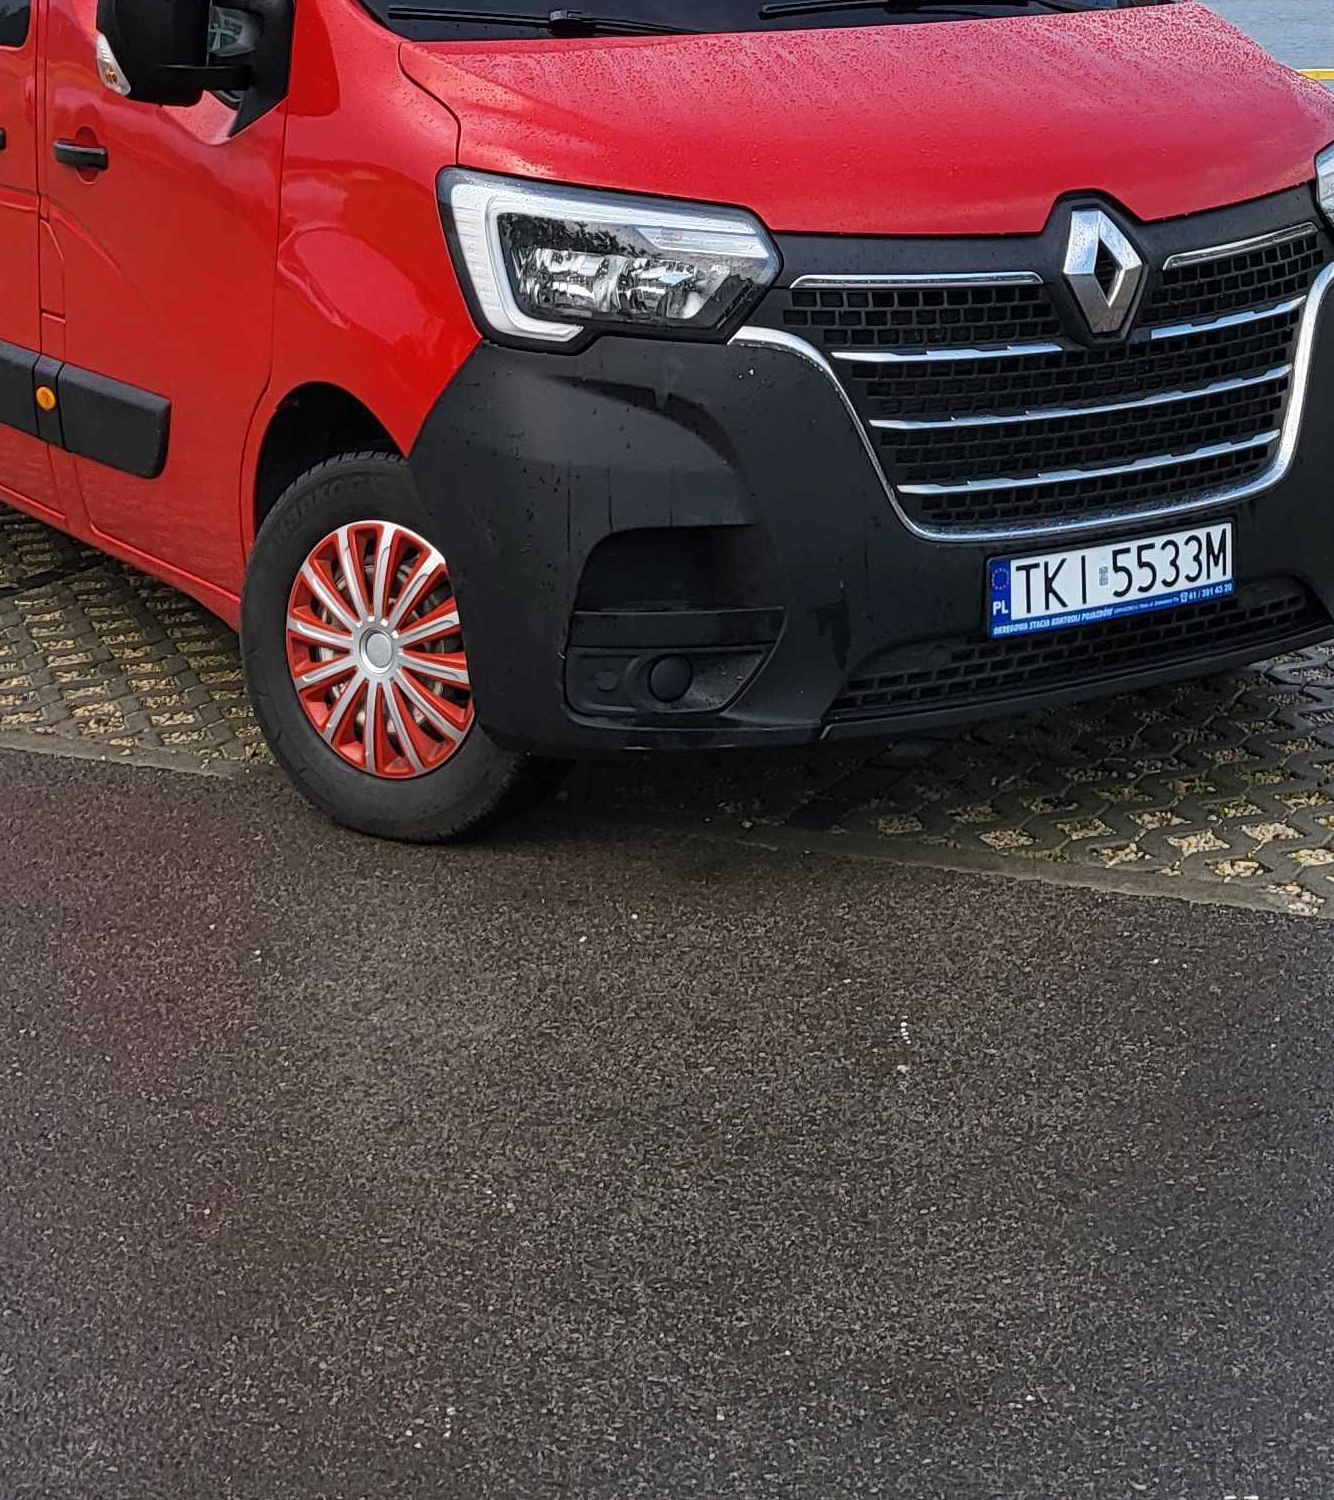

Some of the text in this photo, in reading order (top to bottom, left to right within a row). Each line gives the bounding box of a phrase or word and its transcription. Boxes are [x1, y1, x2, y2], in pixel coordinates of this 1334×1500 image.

[1015, 528, 1227, 614] TKI 5533M
[993, 600, 1009, 616] PL
